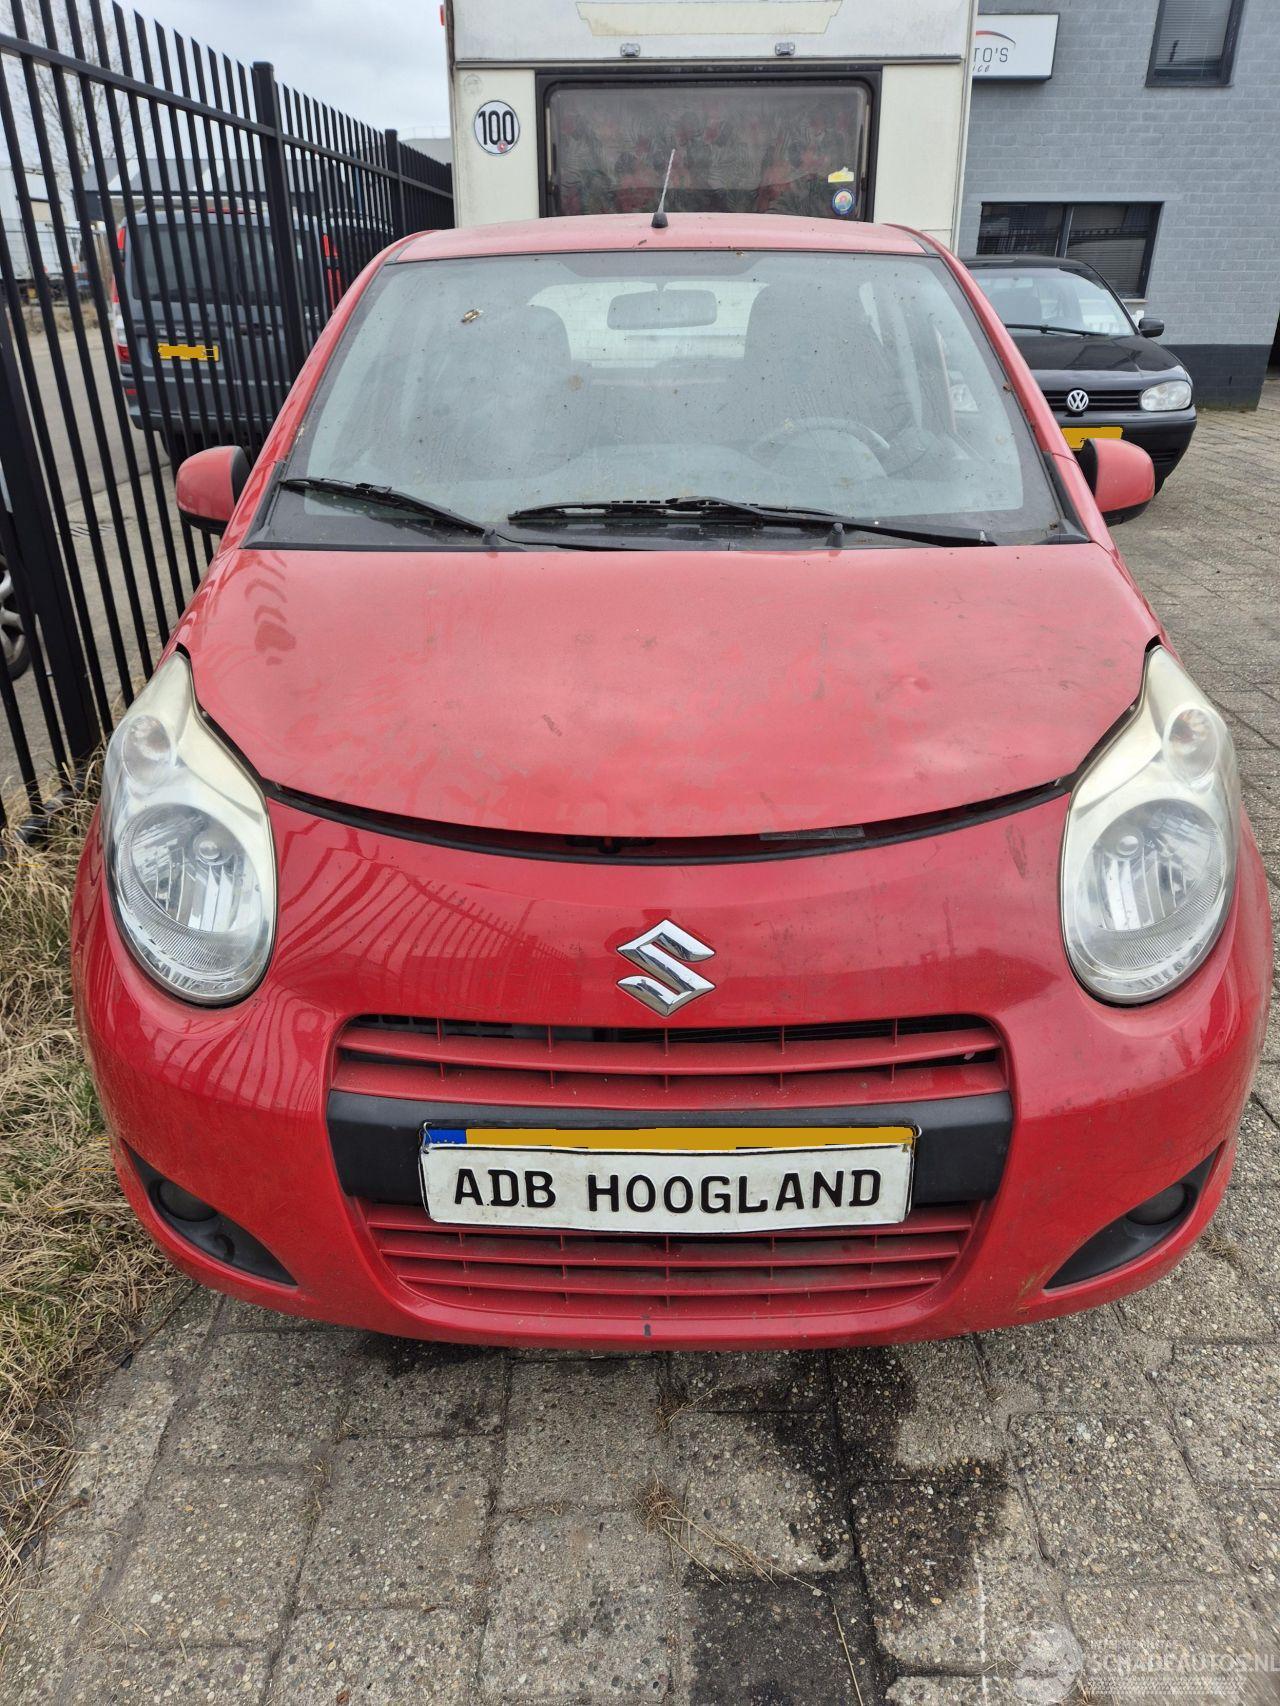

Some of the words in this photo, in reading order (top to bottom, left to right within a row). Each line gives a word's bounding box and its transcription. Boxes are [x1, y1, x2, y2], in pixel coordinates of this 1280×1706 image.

[973, 47, 1009, 63] TO'S
[478, 110, 515, 146] 100
[587, 1169, 882, 1214] HOOGLAND
